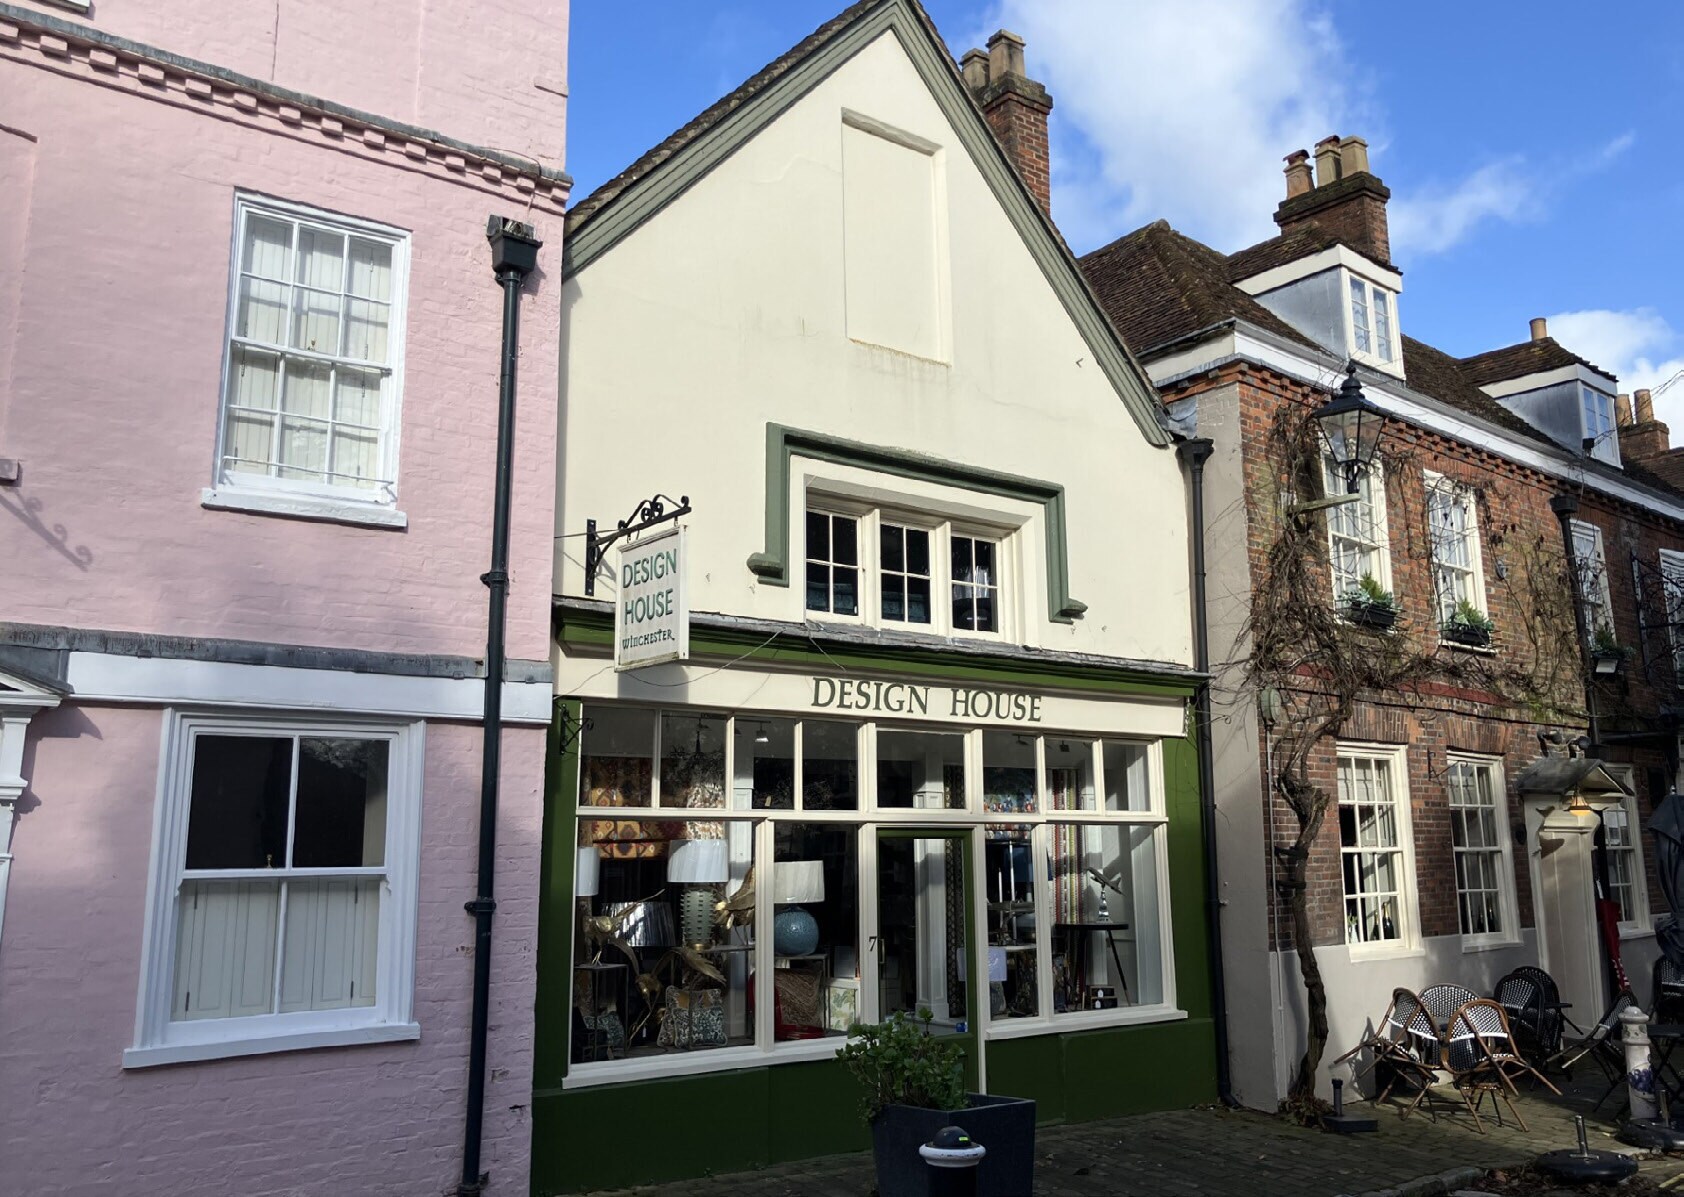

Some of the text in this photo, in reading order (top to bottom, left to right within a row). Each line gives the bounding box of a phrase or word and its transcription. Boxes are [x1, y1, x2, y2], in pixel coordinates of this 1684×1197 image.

[622, 548, 677, 588] DESIGN
[624, 588, 673, 625] HOUSE
[811, 677, 1042, 722] DESIGN HOUSE
[869, 936, 877, 952] 7
